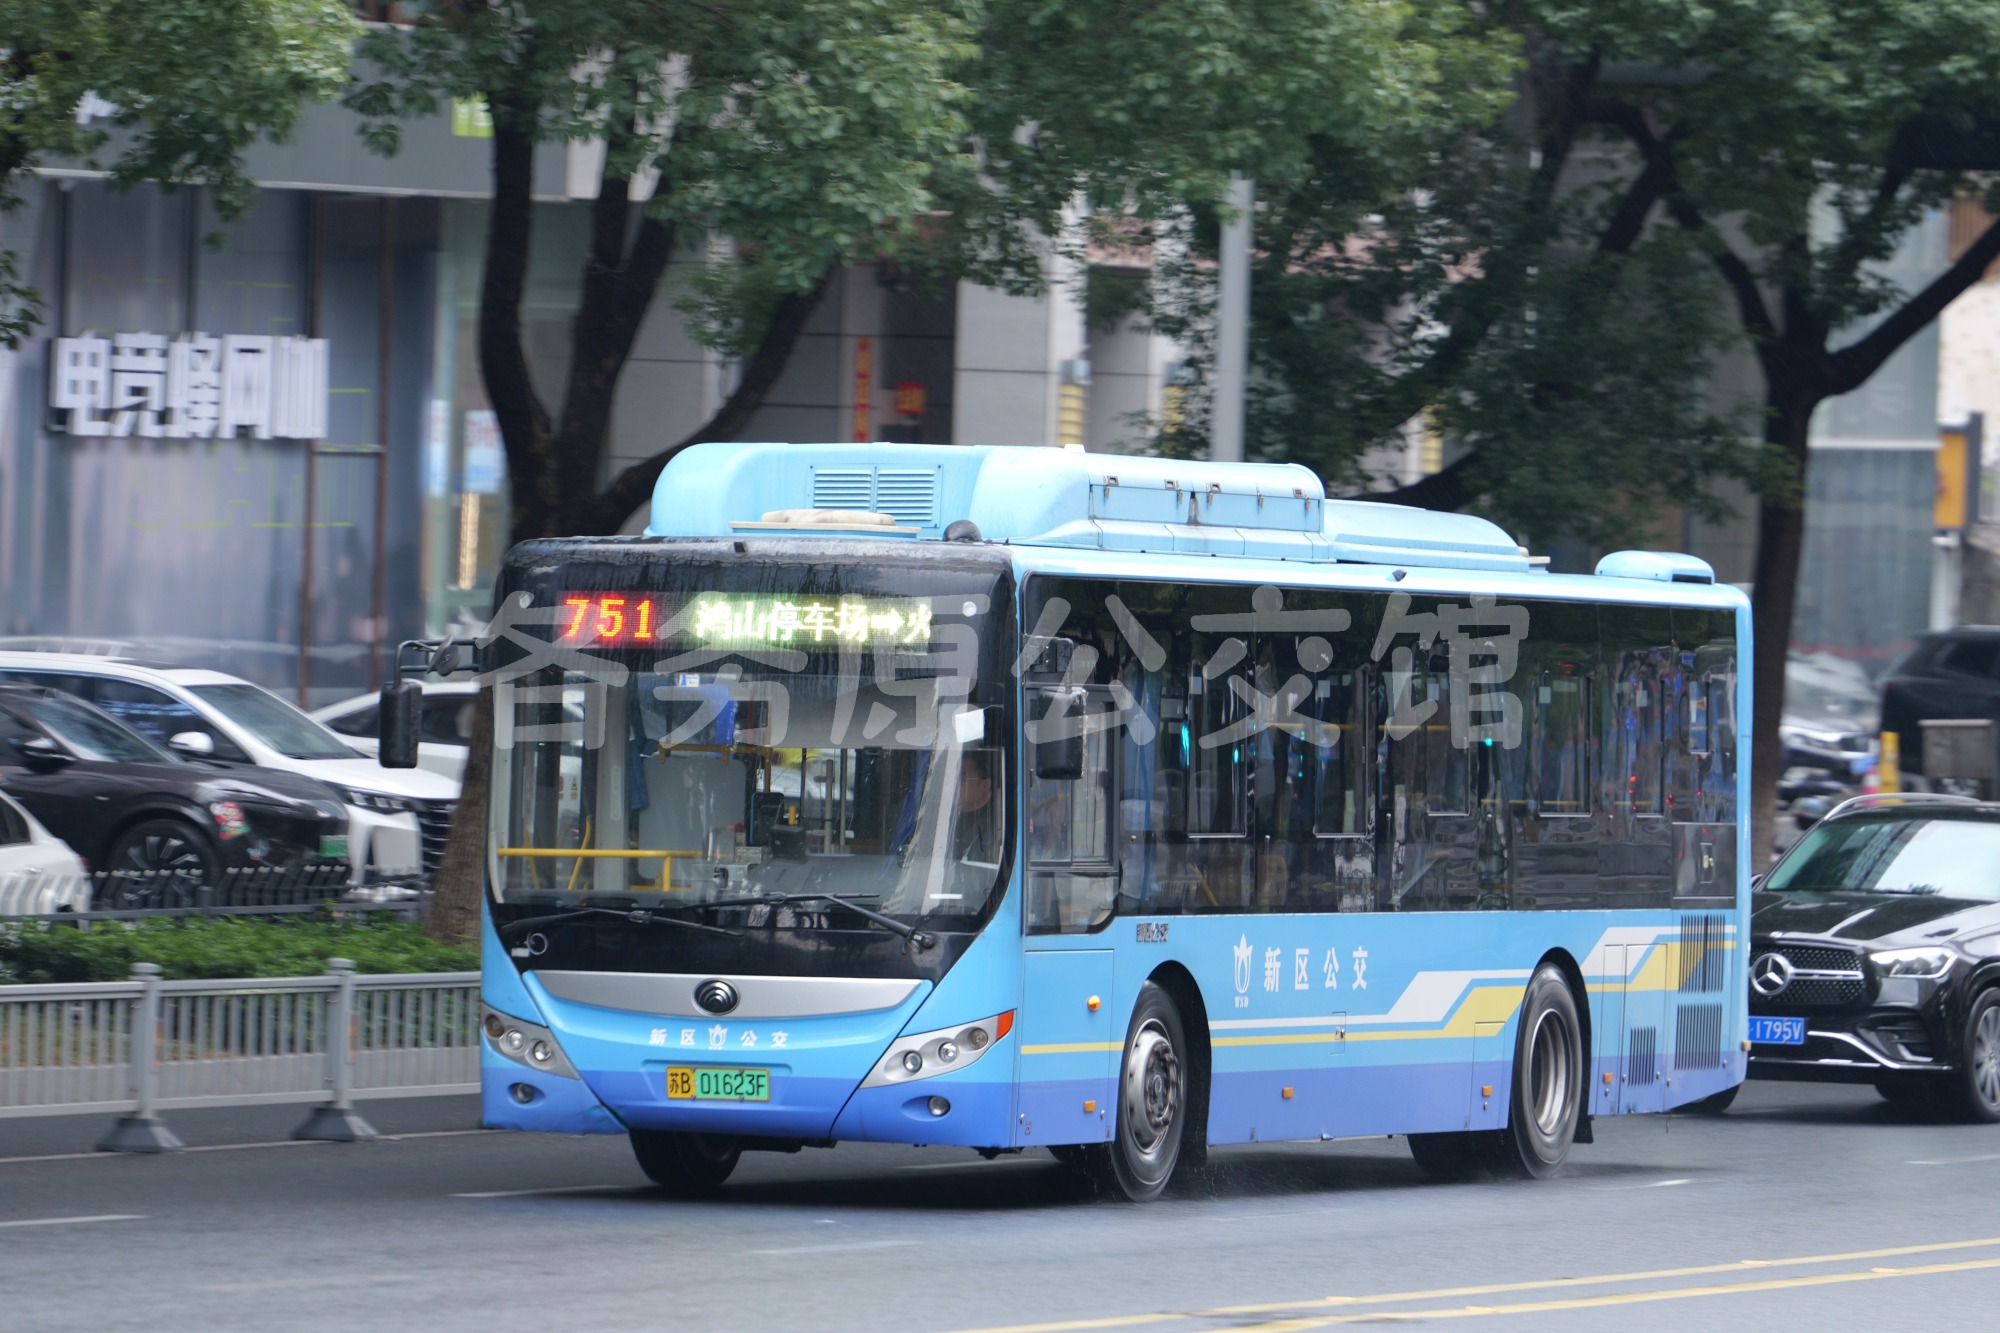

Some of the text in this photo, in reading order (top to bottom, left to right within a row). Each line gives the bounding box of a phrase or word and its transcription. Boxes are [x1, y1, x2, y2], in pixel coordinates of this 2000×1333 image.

[565, 598, 653, 638] 751
[1264, 946, 1368, 992] 新区公交
[1756, 1021, 1802, 1040] 1795V
